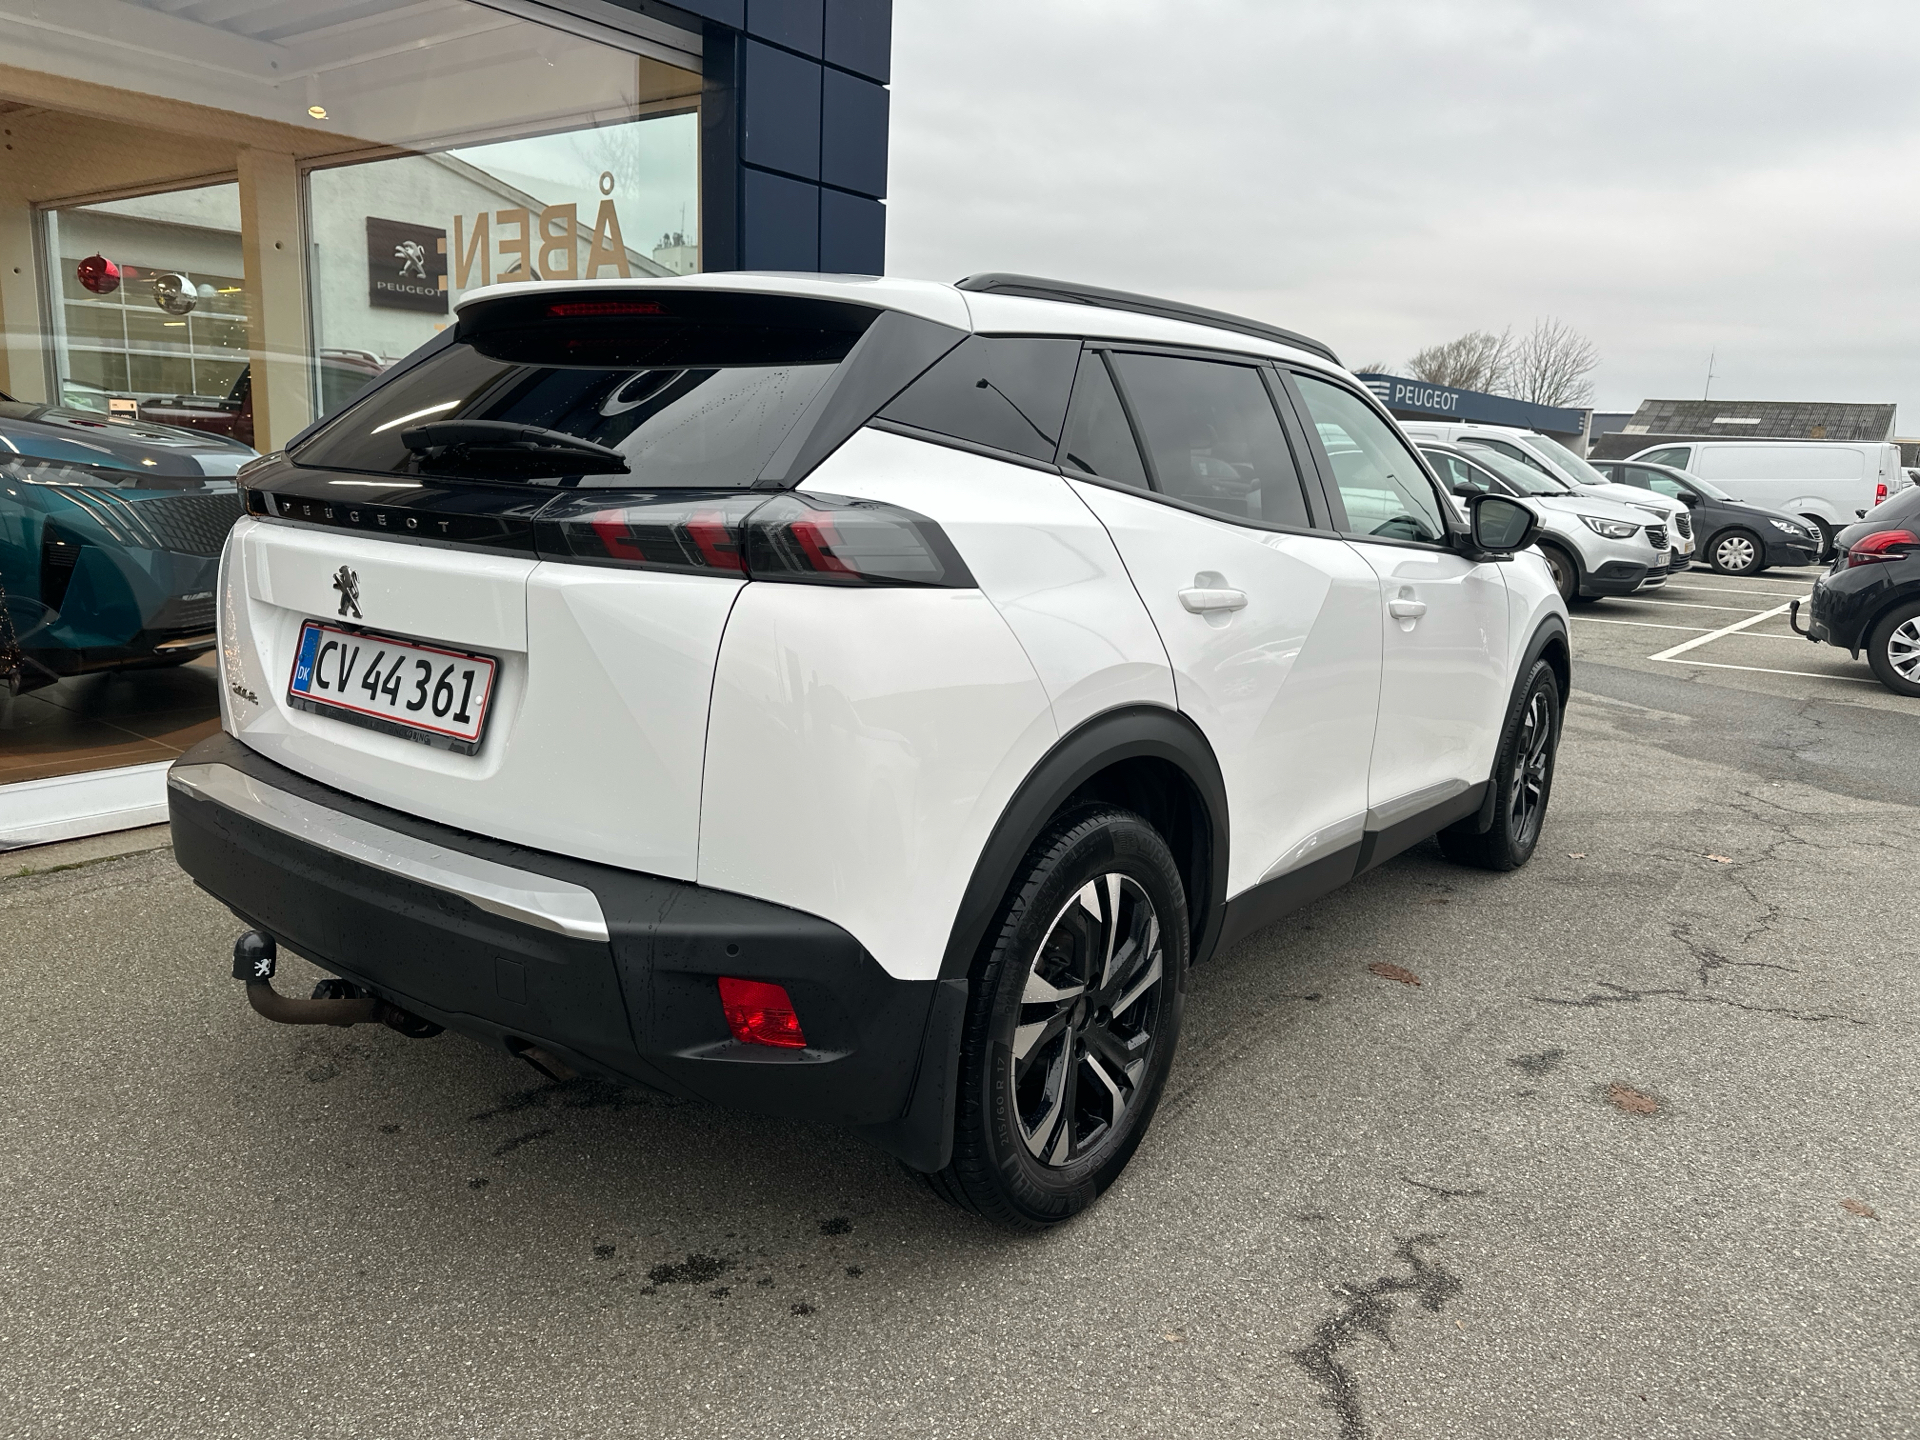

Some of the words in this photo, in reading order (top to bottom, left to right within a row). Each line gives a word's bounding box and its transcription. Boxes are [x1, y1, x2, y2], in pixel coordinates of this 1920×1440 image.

[377, 280, 442, 298] PEUGEOT
[1395, 384, 1459, 411] PEUGEOT
[282, 501, 450, 533] PEUGEOT
[297, 665, 310, 682] DK
[315, 640, 360, 693] CV
[361, 650, 406, 706] 44
[405, 659, 476, 725] 361
[997, 1056, 1006, 1073] 17
[995, 1080, 1005, 1091] R
[995, 1096, 1010, 1147] 215/60
